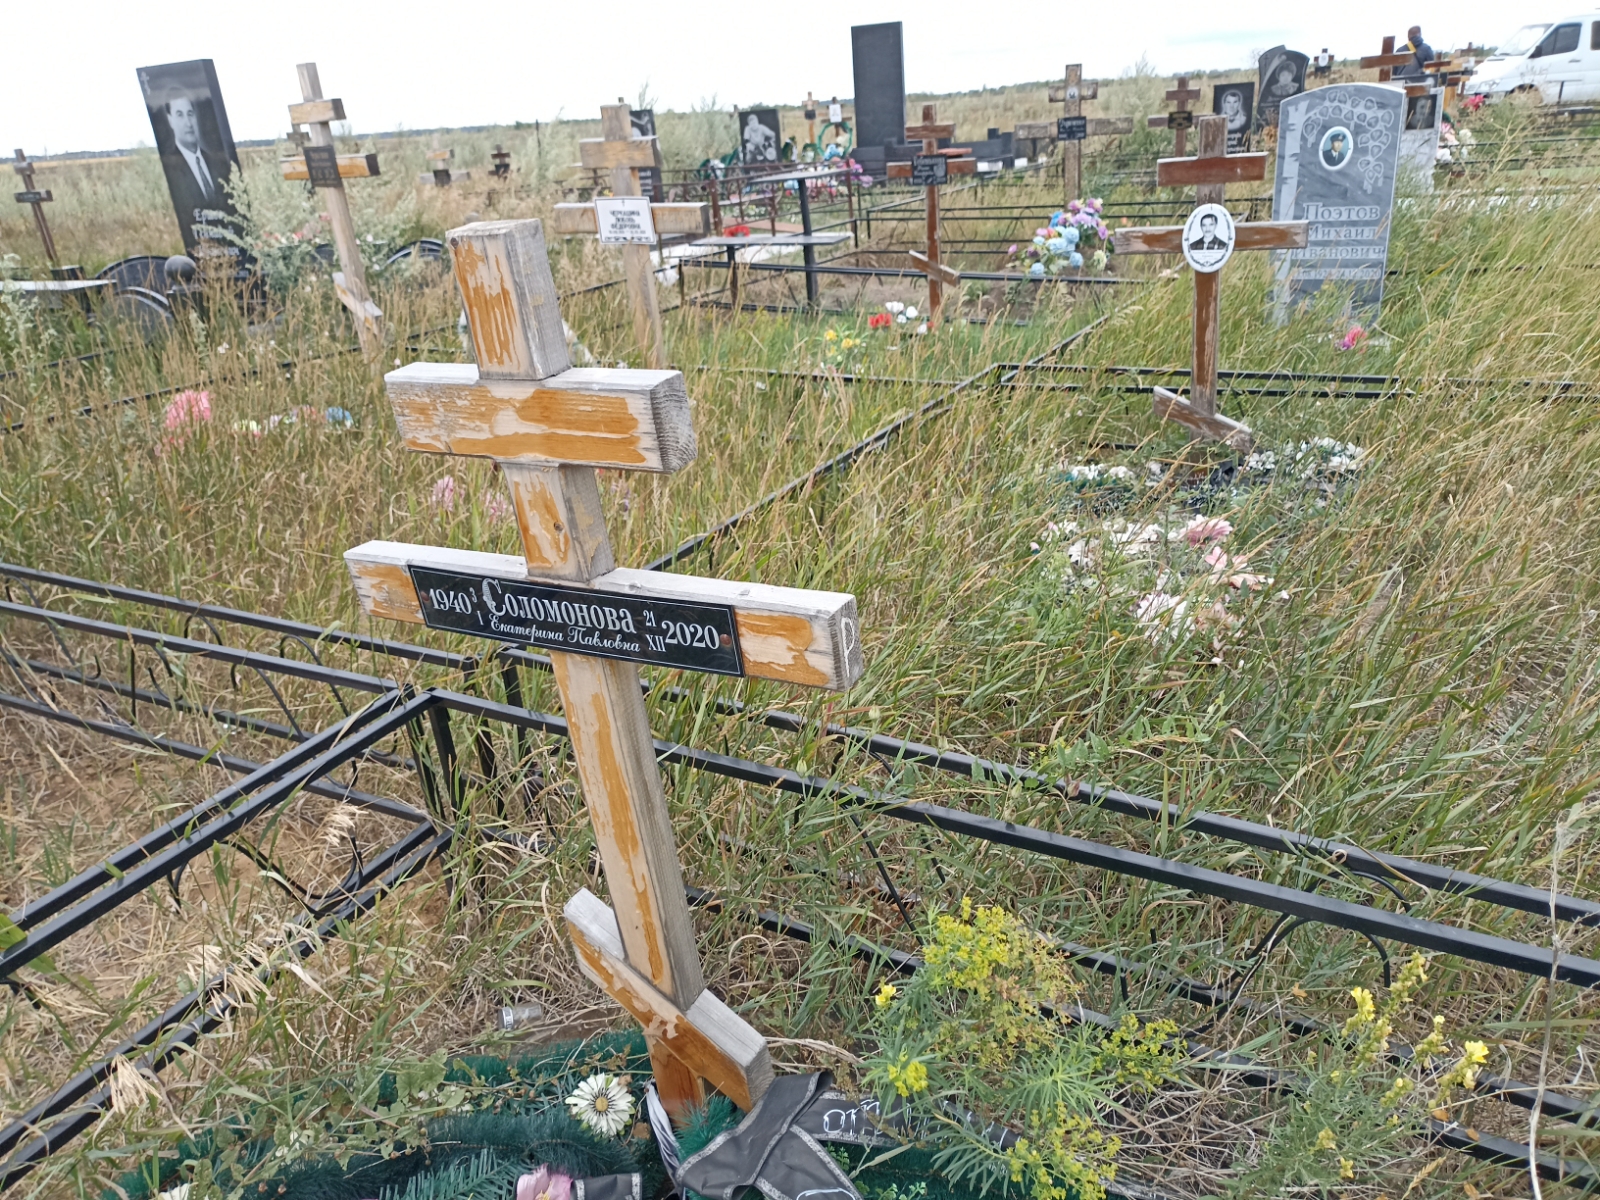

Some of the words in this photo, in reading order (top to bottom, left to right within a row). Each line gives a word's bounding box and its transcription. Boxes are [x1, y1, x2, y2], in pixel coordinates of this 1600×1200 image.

[1303, 203, 1380, 220] Поэтов
[429, 588, 472, 615] 1940
[482, 577, 636, 634] Соломонова
[489, 613, 564, 643] Екатерина
[567, 626, 641, 652] Павловна
[662, 620, 720, 650] 2020
